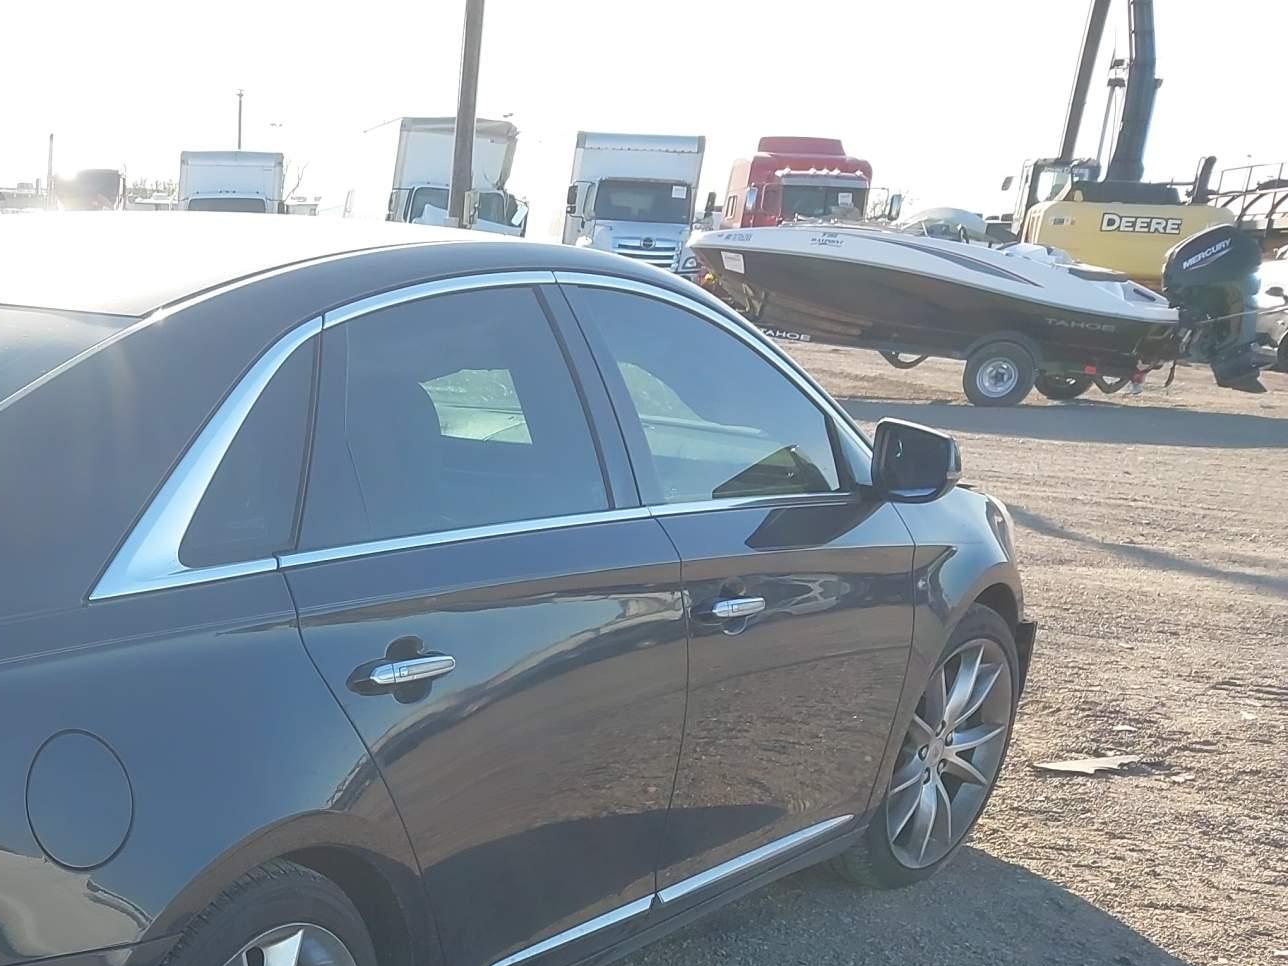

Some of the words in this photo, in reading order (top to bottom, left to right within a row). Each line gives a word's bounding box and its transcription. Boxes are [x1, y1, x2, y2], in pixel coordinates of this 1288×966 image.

[1101, 213, 1182, 234] DEERE
[1183, 238, 1232, 270] MERCURY
[1046, 318, 1116, 332] TAHOE
[759, 327, 811, 341] TAHOE
